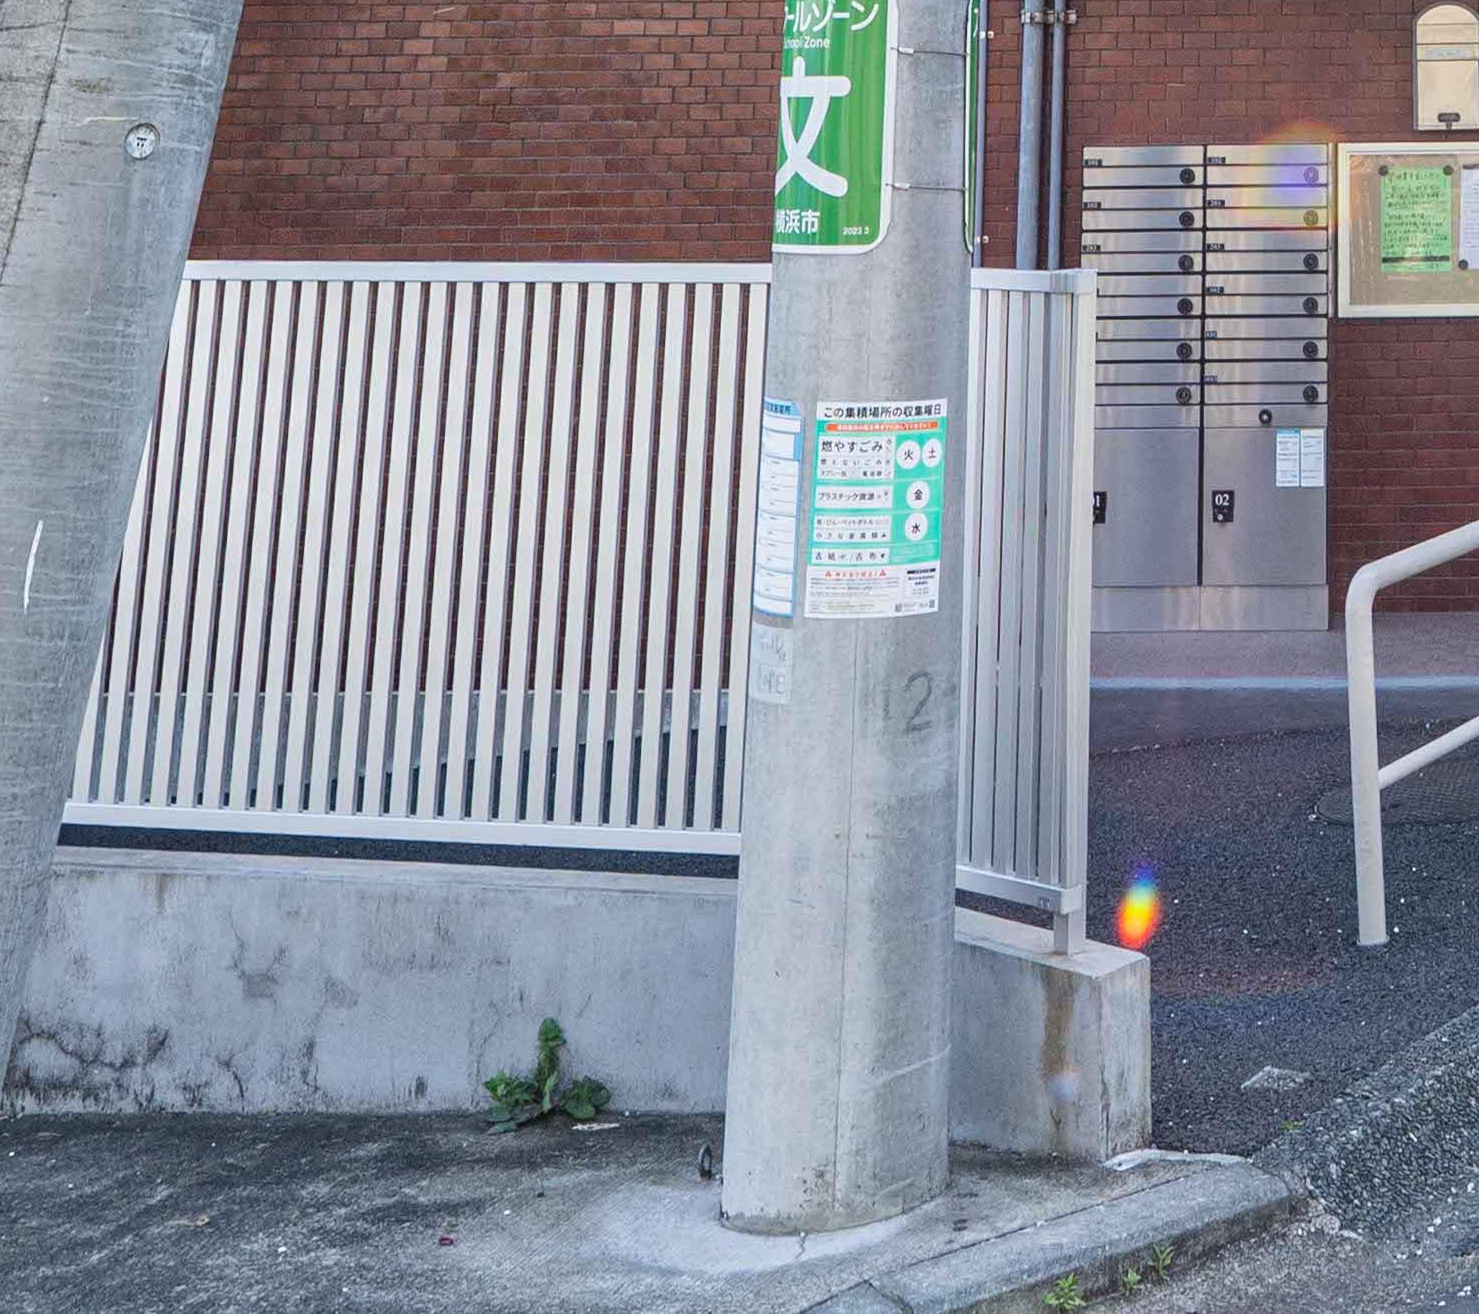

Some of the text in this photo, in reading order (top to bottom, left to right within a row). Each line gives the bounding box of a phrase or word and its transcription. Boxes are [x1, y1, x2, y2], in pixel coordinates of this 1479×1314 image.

[804, 35, 831, 49] Zone
[824, 403, 941, 419] この集積場所の収集曜日
[821, 440, 883, 454] 燃やすごみ
[903, 447, 937, 460] 火 土
[914, 489, 923, 501] 金
[1215, 493, 1230, 507] 02
[911, 523, 921, 534] 水
